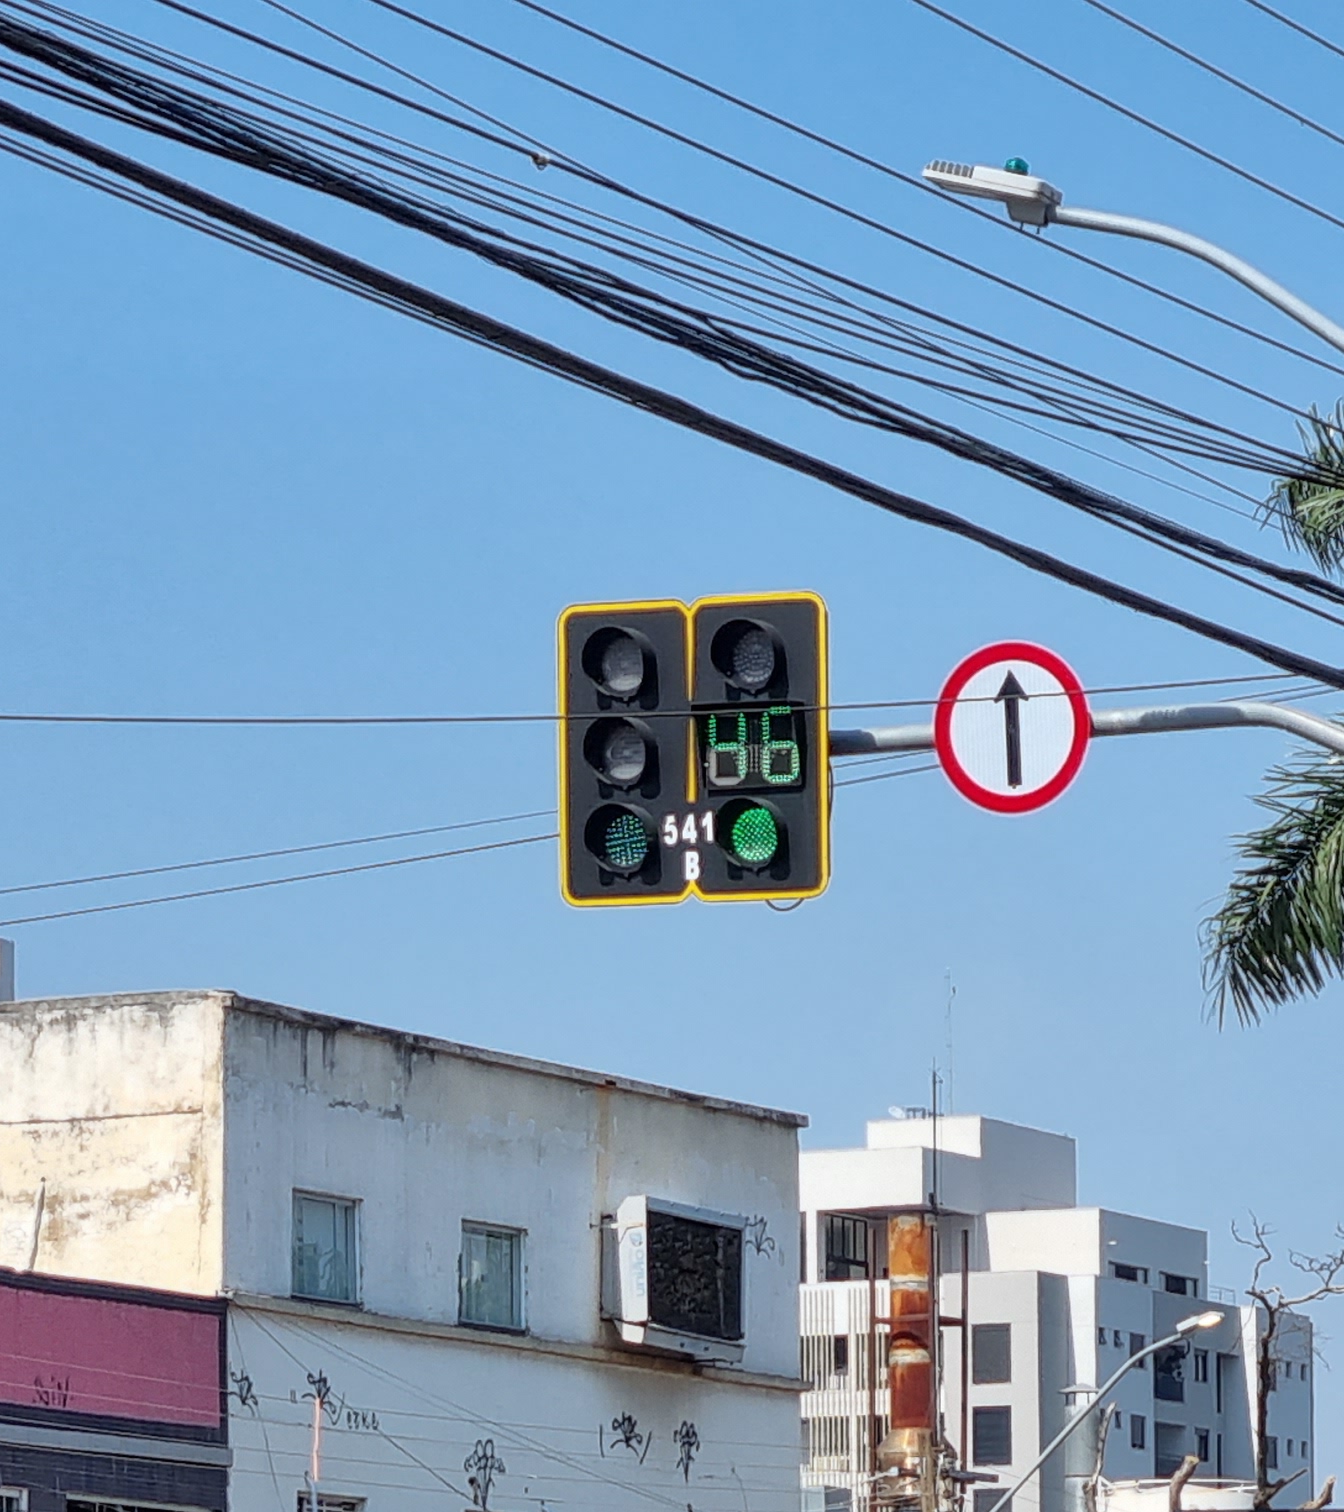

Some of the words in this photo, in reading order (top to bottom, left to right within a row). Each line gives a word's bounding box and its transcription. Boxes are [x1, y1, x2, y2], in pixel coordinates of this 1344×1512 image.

[708, 706, 800, 783] 46
[664, 811, 714, 845] 541
[685, 851, 700, 880] B
